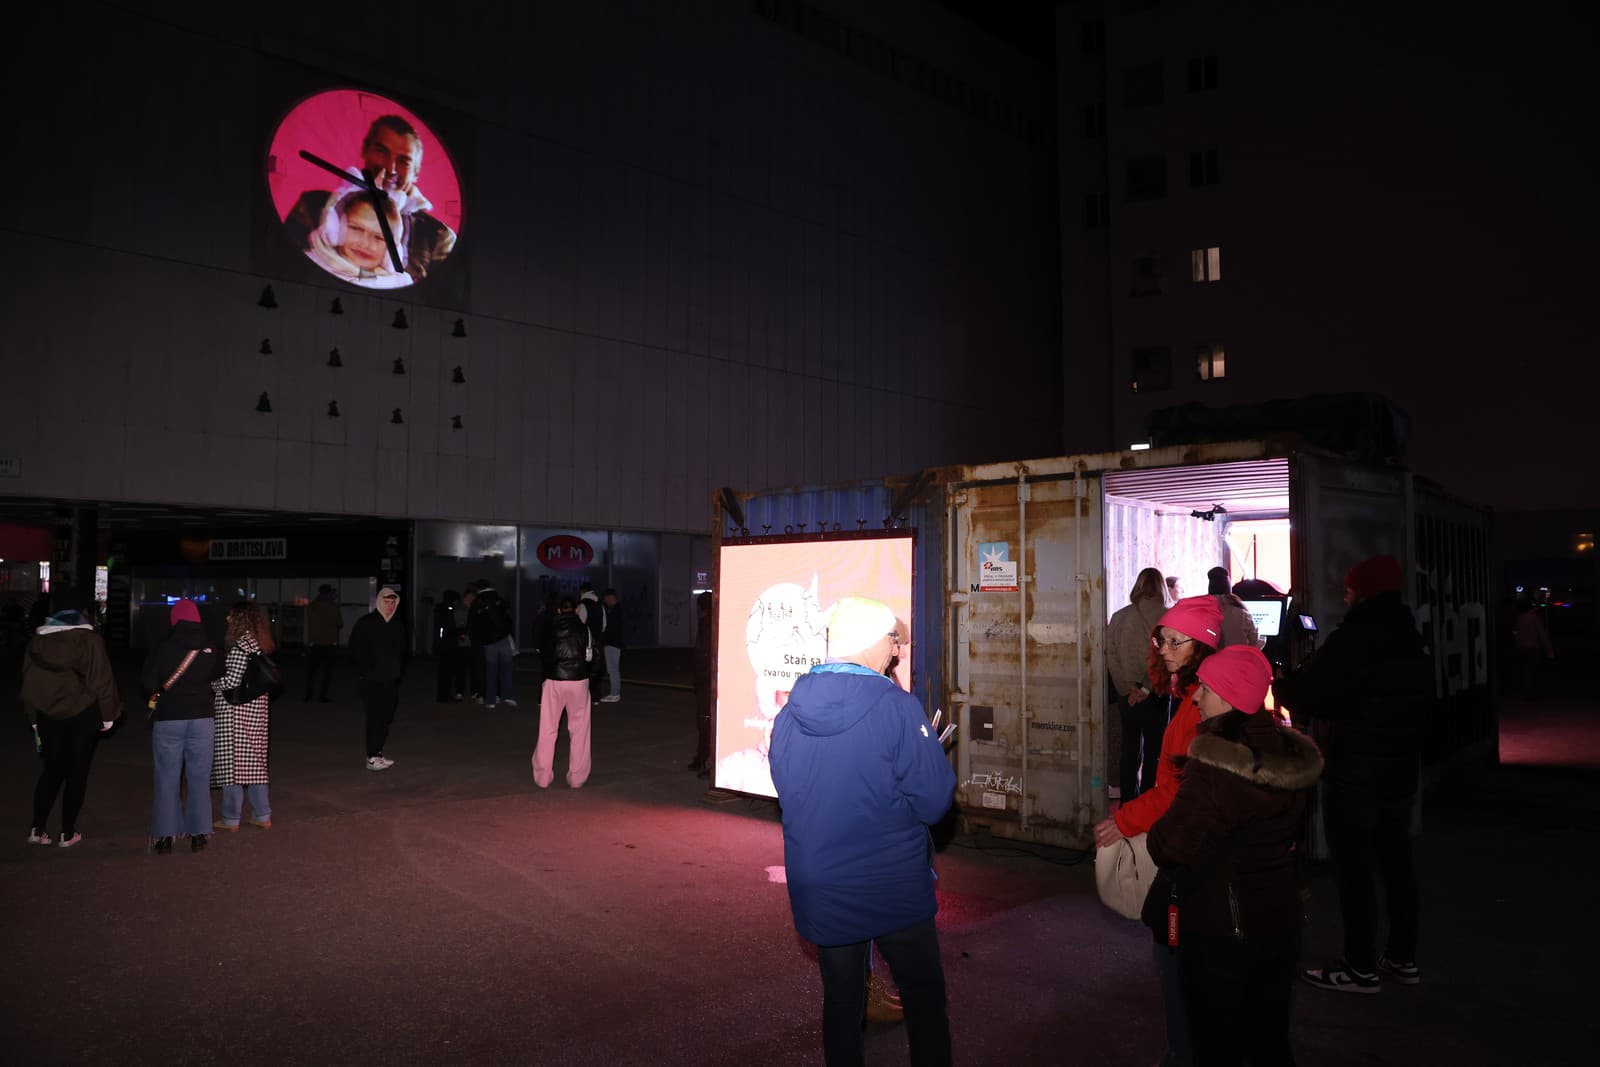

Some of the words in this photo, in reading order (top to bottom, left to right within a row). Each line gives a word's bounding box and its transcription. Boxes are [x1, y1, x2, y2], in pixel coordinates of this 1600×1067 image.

[227, 540, 284, 557] BRATISLAVA
[810, 657, 821, 665] sa
[764, 668, 791, 678] tvarou
